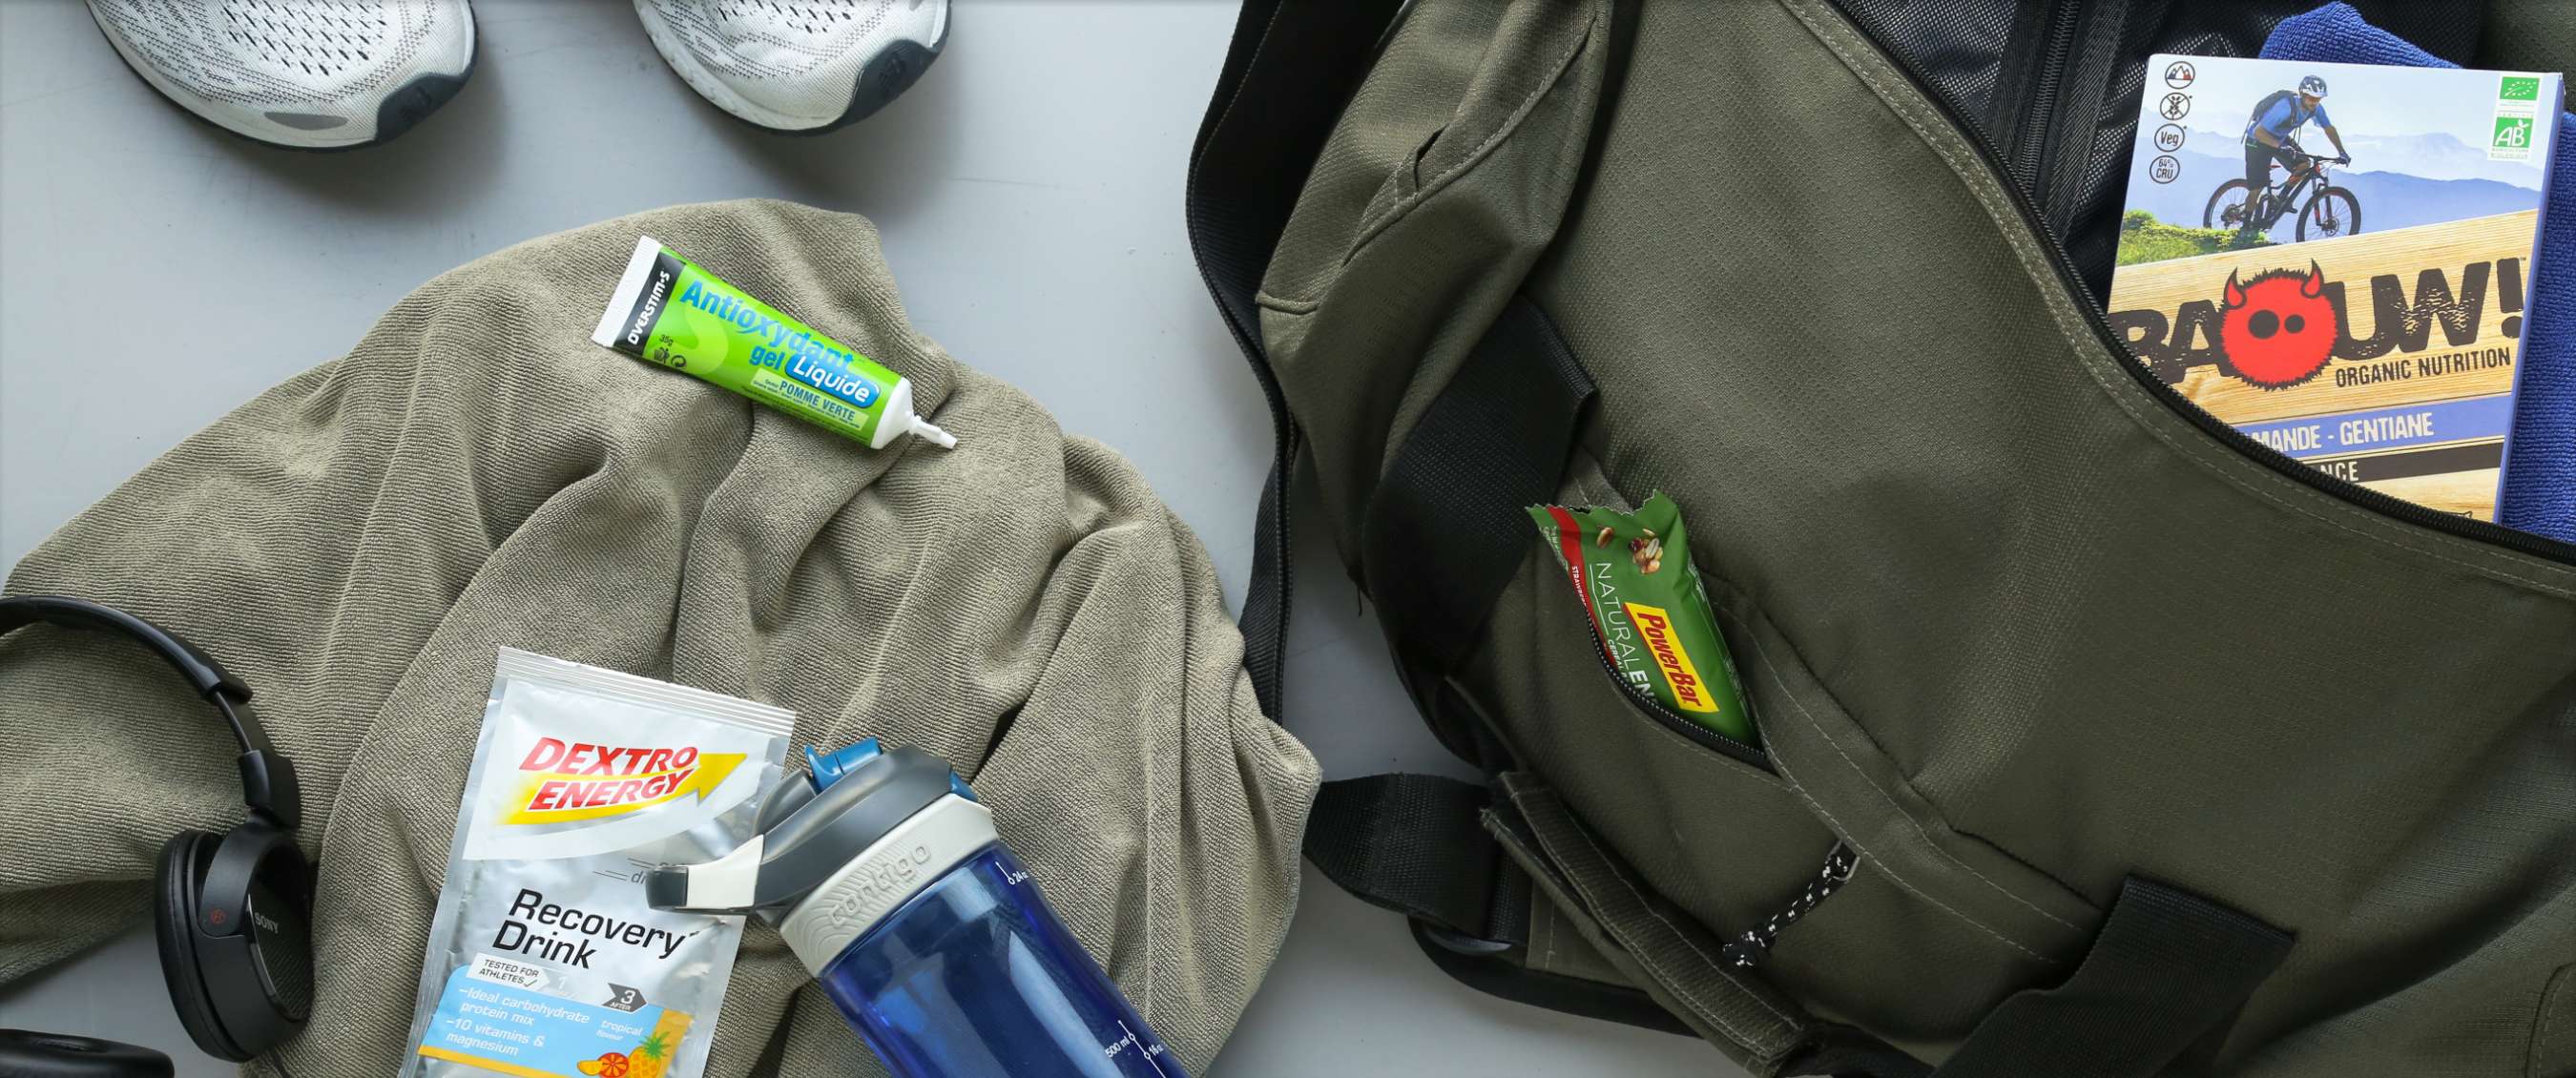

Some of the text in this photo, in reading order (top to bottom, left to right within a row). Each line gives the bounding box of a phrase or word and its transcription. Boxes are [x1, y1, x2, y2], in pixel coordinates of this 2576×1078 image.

[2161, 131, 2178, 146] Veg
[2155, 168, 2173, 179] CRU
[749, 345, 870, 404] gel Liquide
[2336, 346, 2512, 388] ORGANIC NUTRITION
[779, 381, 820, 406] POMME
[822, 399, 856, 422] VERTE
[2247, 425, 2322, 452] MANDE
[2339, 411, 2434, 446] GENTIANE
[1637, 612, 1703, 707] PowerBar
[519, 736, 699, 777] DEXTRO
[529, 768, 694, 811] ENERGY
[254, 912, 279, 934] SONY
[508, 887, 686, 961] Recovery
[491, 919, 597, 970] Drink
[478, 968, 526, 985] ATHLETES
[483, 959, 539, 977] TESTED FOR
[610, 1000, 632, 1012] AFTER
[620, 989, 636, 1005] 3
[459, 1001, 535, 1026] protein mix
[502, 997, 591, 1025] carbohydrate
[474, 1021, 530, 1045] vitamins
[532, 1034, 546, 1048] &
[600, 1019, 644, 1038] tropical
[446, 1031, 520, 1058] magnesium
[1105, 1043, 1122, 1058] 500
